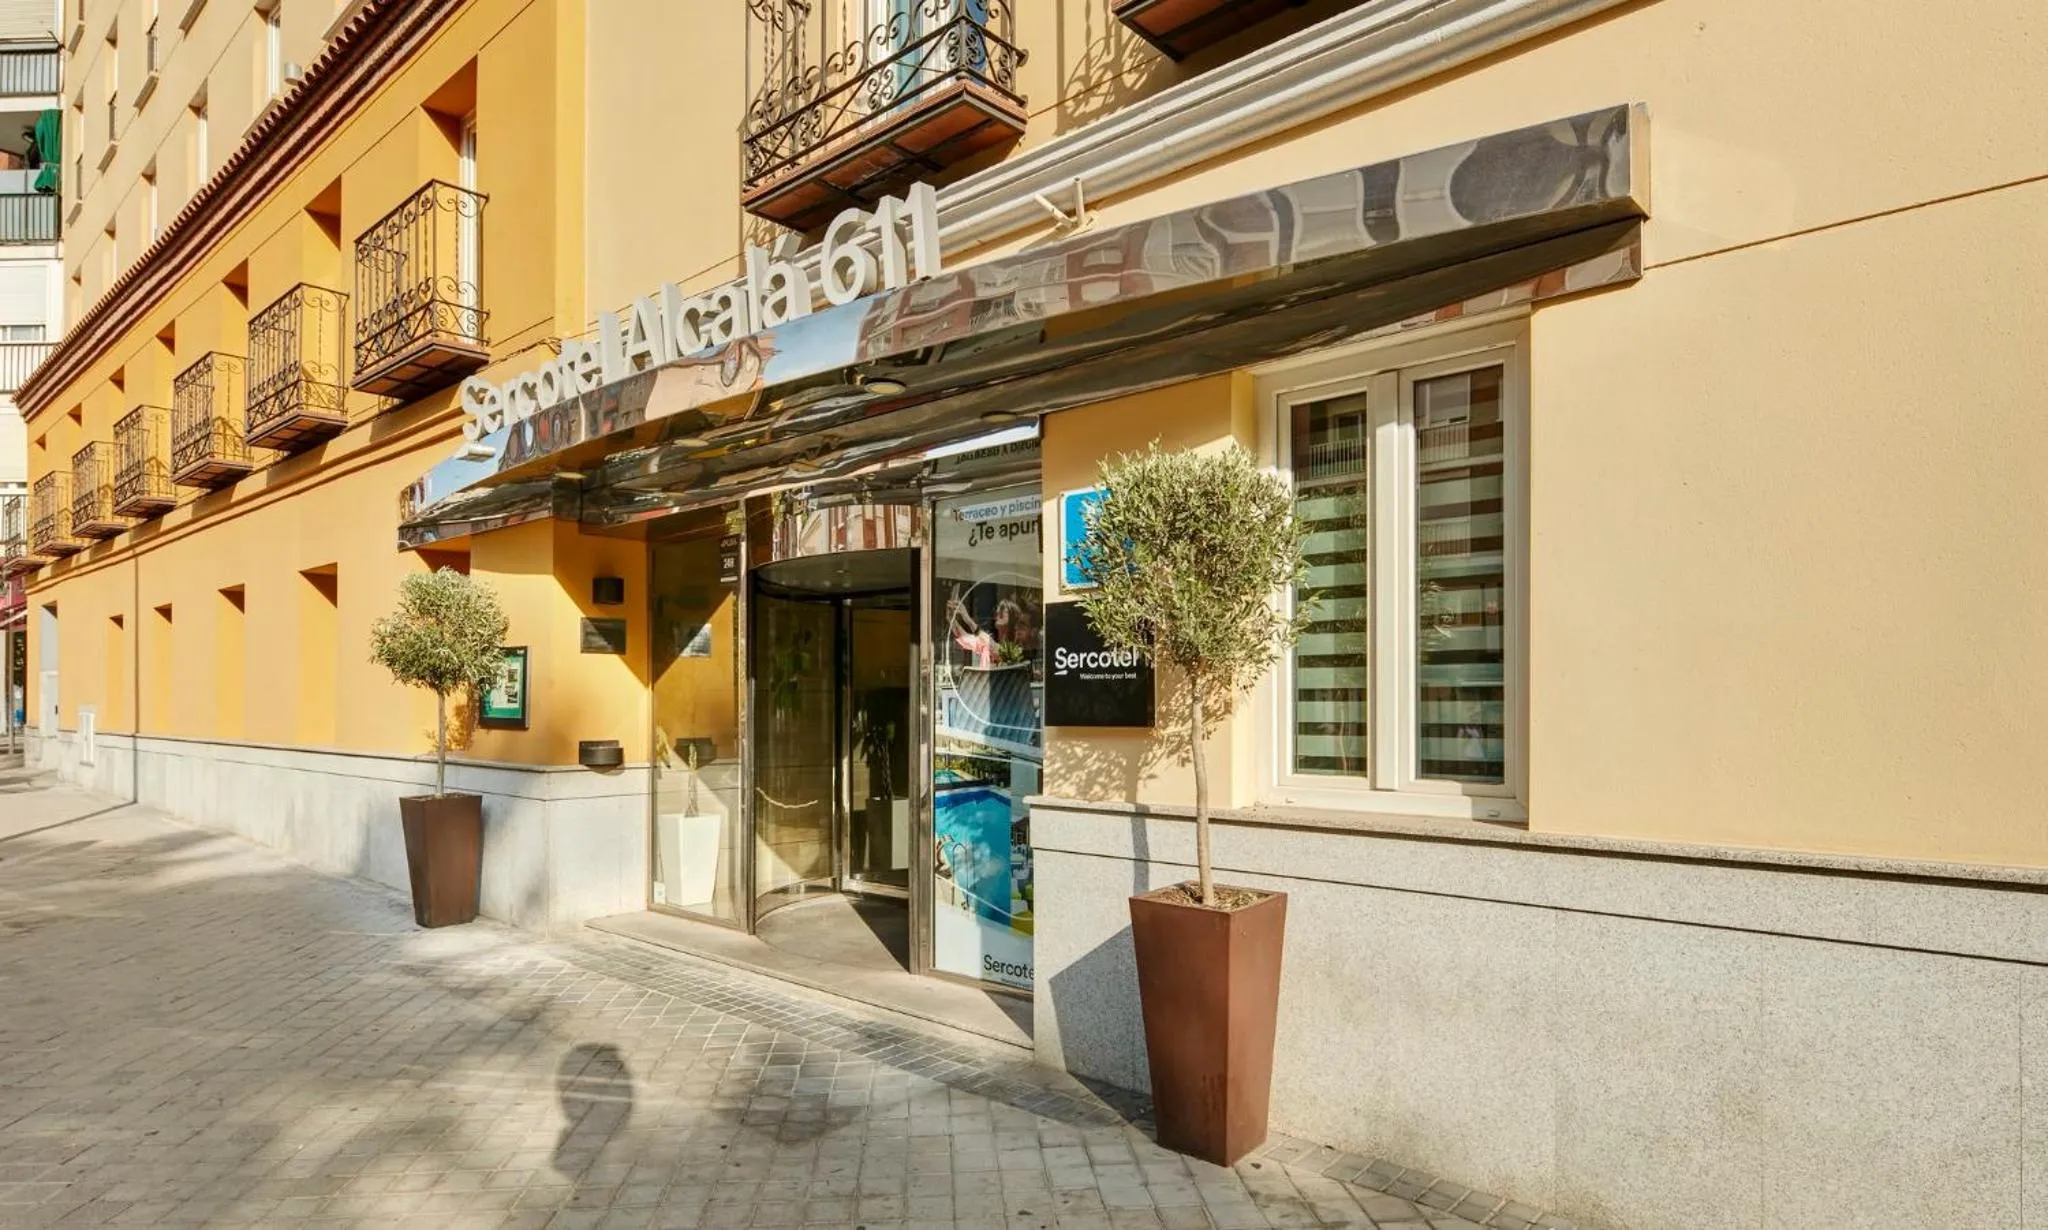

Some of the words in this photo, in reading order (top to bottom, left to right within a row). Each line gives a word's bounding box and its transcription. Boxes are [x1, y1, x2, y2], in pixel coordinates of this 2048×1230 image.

[459, 312, 621, 441] Sercotel
[624, 233, 812, 374] Alcalá
[820, 181, 941, 305] 611
[1055, 646, 1137, 669] Sercotel
